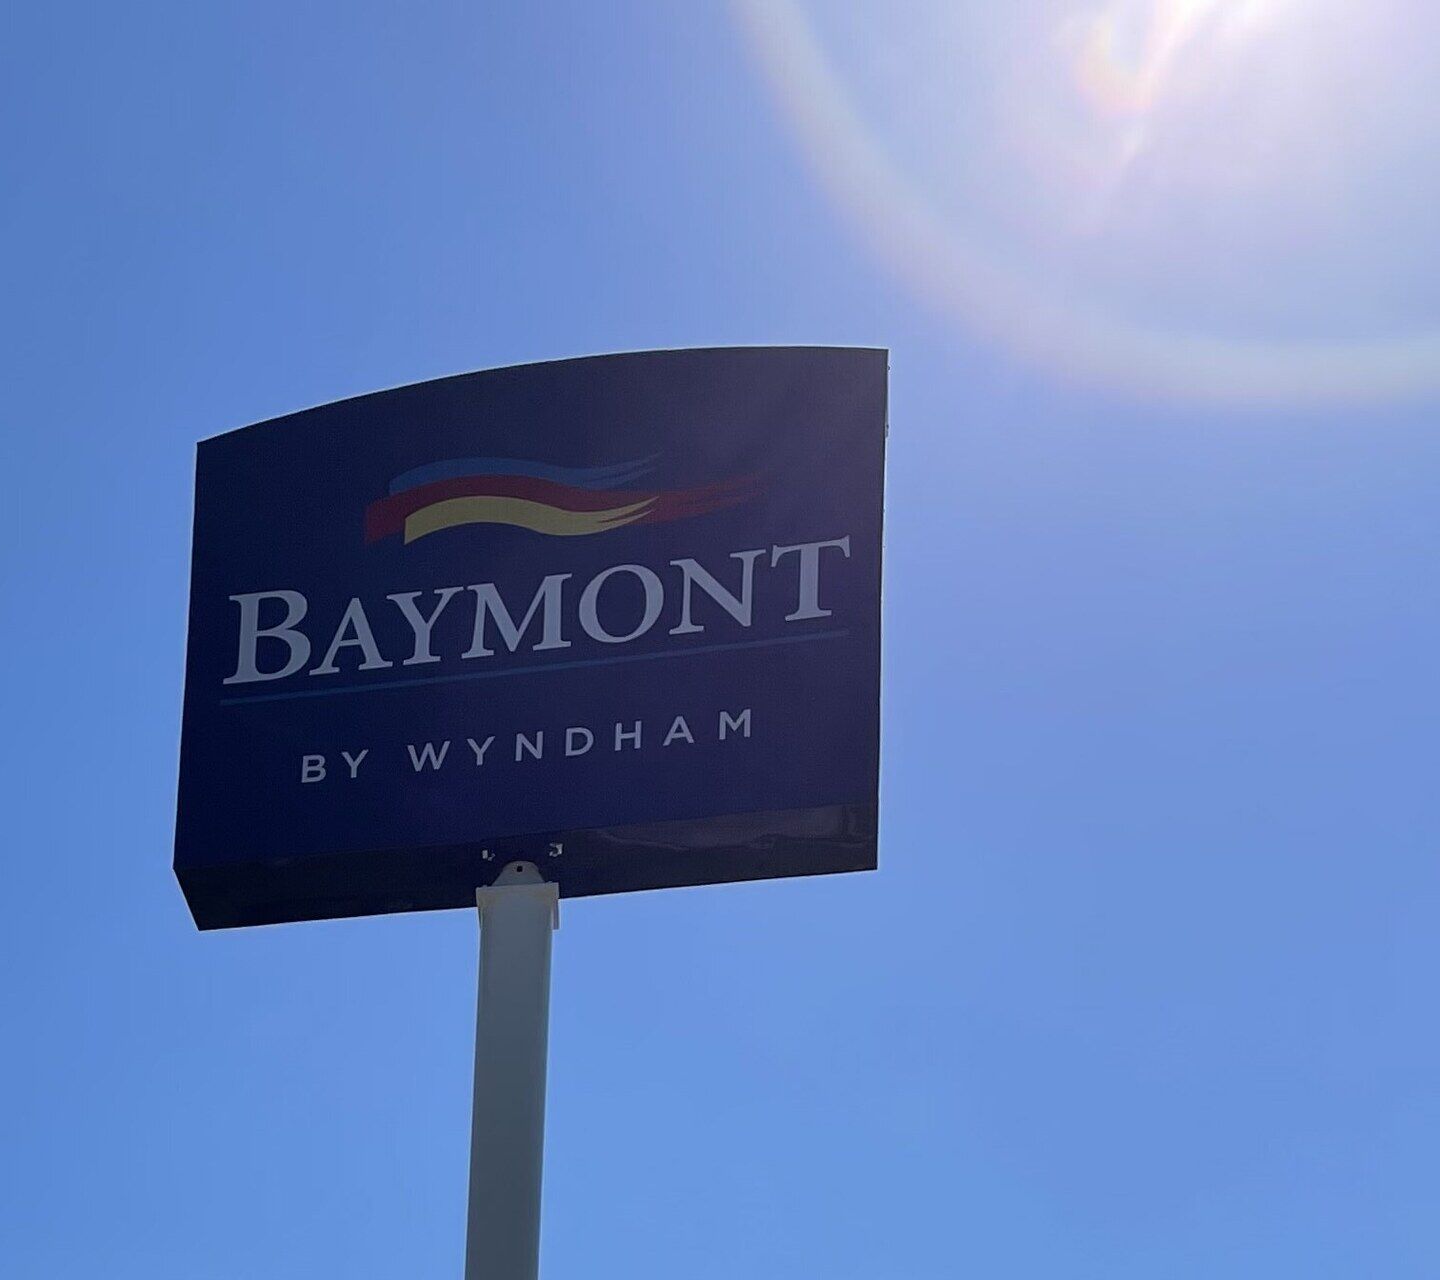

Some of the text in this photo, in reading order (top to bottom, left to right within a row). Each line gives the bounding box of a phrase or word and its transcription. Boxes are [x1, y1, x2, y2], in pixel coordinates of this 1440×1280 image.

[222, 535, 851, 685] BAYMONT
[301, 708, 751, 783] BY WYNDHAM
